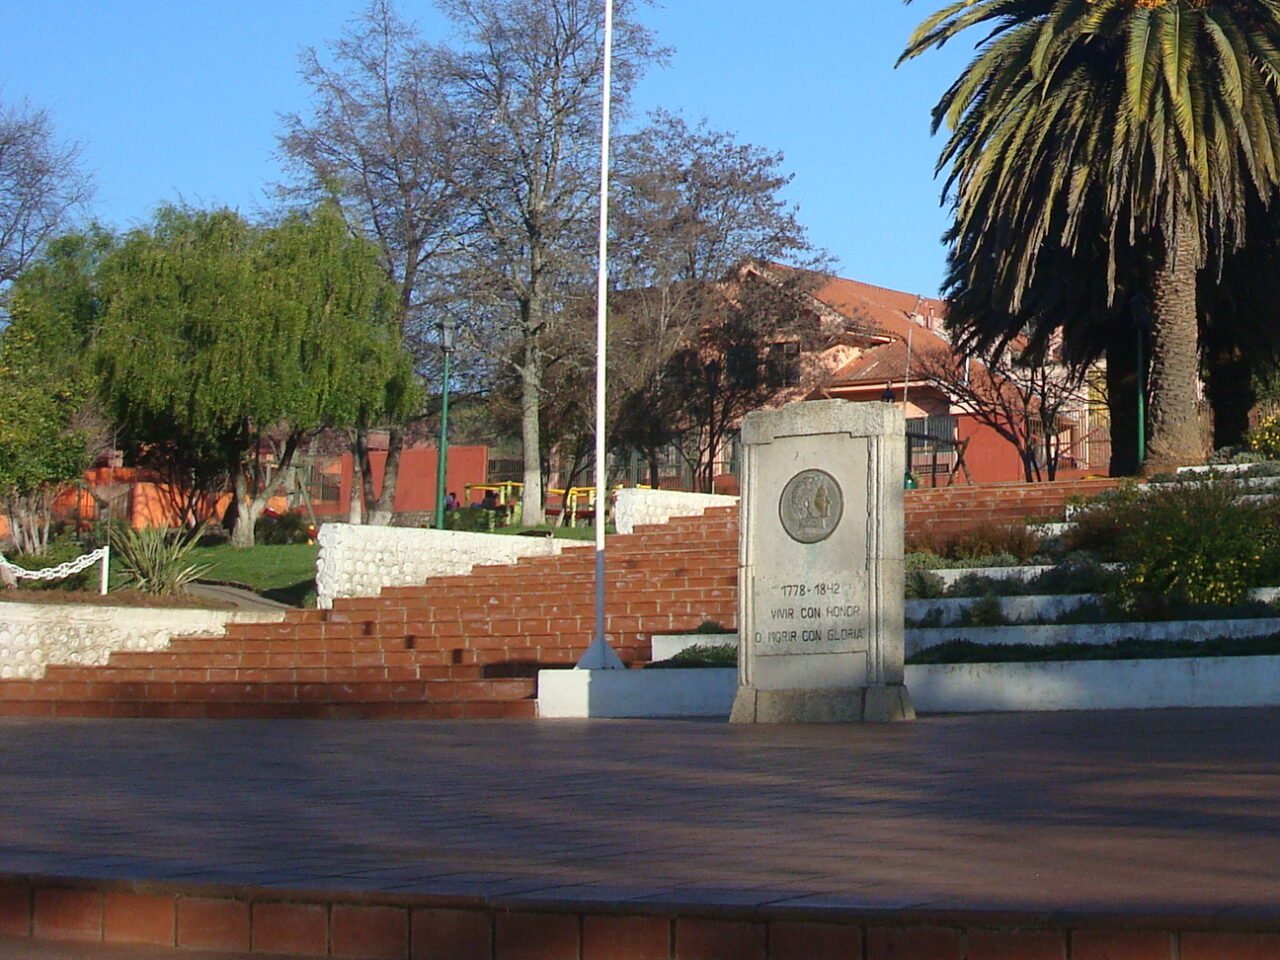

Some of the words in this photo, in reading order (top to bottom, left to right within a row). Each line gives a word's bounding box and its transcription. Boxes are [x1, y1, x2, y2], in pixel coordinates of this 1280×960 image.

[770, 607, 795, 619] VIVIR
[800, 607, 821, 619] CON
[826, 605, 860, 618] HONOR
[754, 631, 762, 643] O
[768, 630, 797, 643] MORIR
[802, 629, 822, 642] CON
